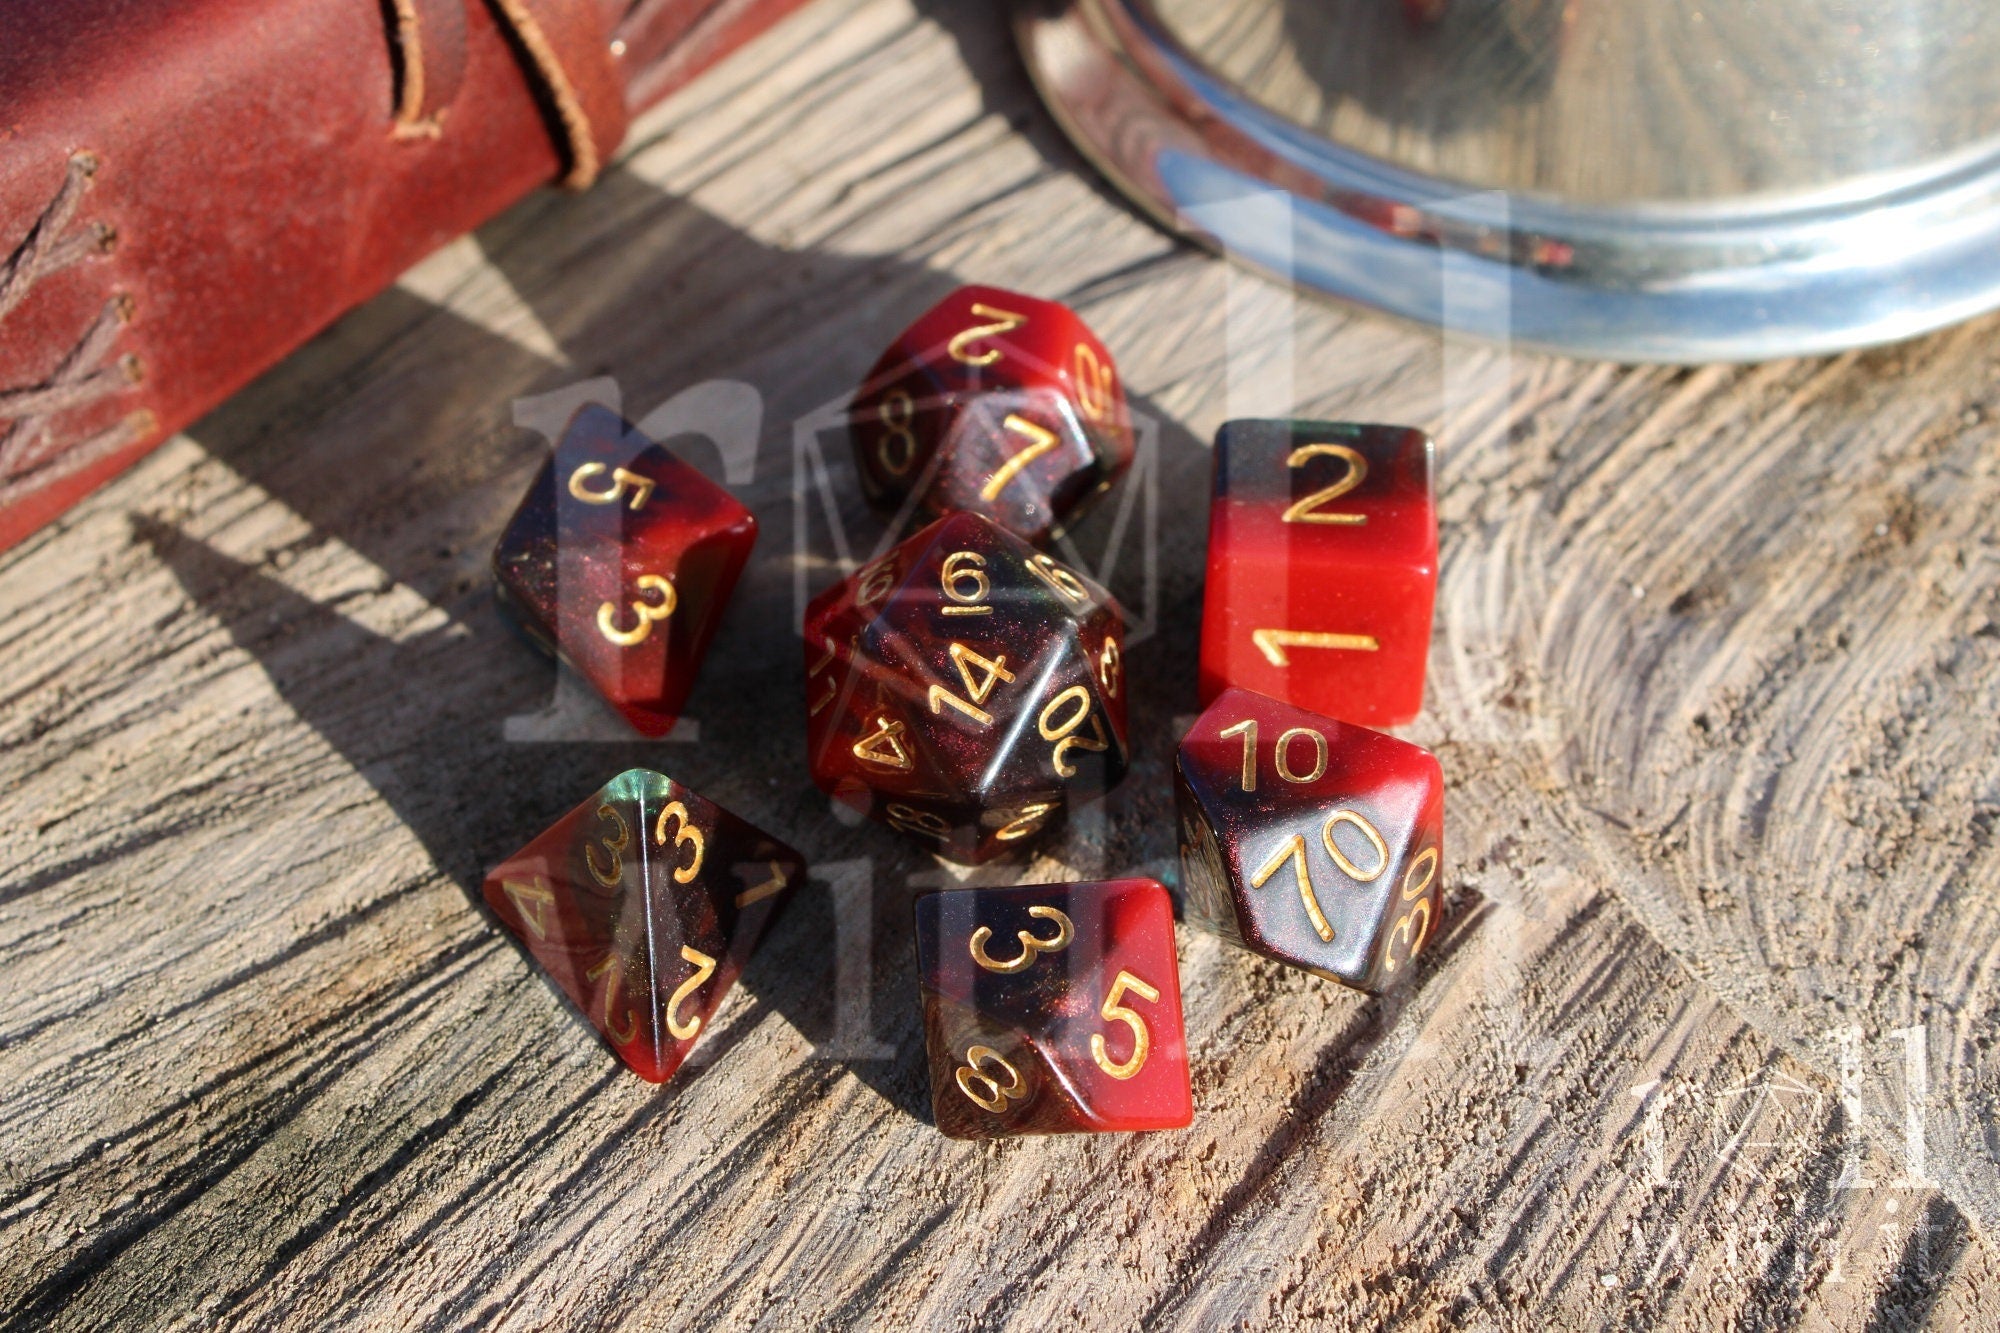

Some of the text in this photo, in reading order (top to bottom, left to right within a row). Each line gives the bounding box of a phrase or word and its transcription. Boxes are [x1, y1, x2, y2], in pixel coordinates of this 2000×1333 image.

[949, 302, 1028, 366] 2
[878, 385, 917, 476] 8
[979, 413, 1060, 501] 7
[568, 462, 656, 511] 5
[1281, 443, 1368, 525] 2
[597, 574, 677, 646] 3
[941, 551, 994, 616] 6
[929, 642, 1016, 725] 14
[1252, 628, 1380, 667] 1
[852, 716, 915, 772] 4
[1038, 685, 1109, 779] 20
[1219, 718, 1328, 792] 10
[585, 804, 629, 888] 3
[655, 801, 704, 884] 3
[886, 803, 952, 843] 18
[995, 801, 1060, 841] 2
[502, 876, 554, 940] 4
[735, 858, 787, 909] 1
[1250, 809, 1389, 943] 70
[1385, 847, 1437, 972] 30
[969, 905, 1075, 975] 3
[586, 952, 637, 1046] 2
[666, 944, 717, 1041] 2
[1090, 970, 1160, 1081] 5
[955, 1045, 1028, 1114] 8
